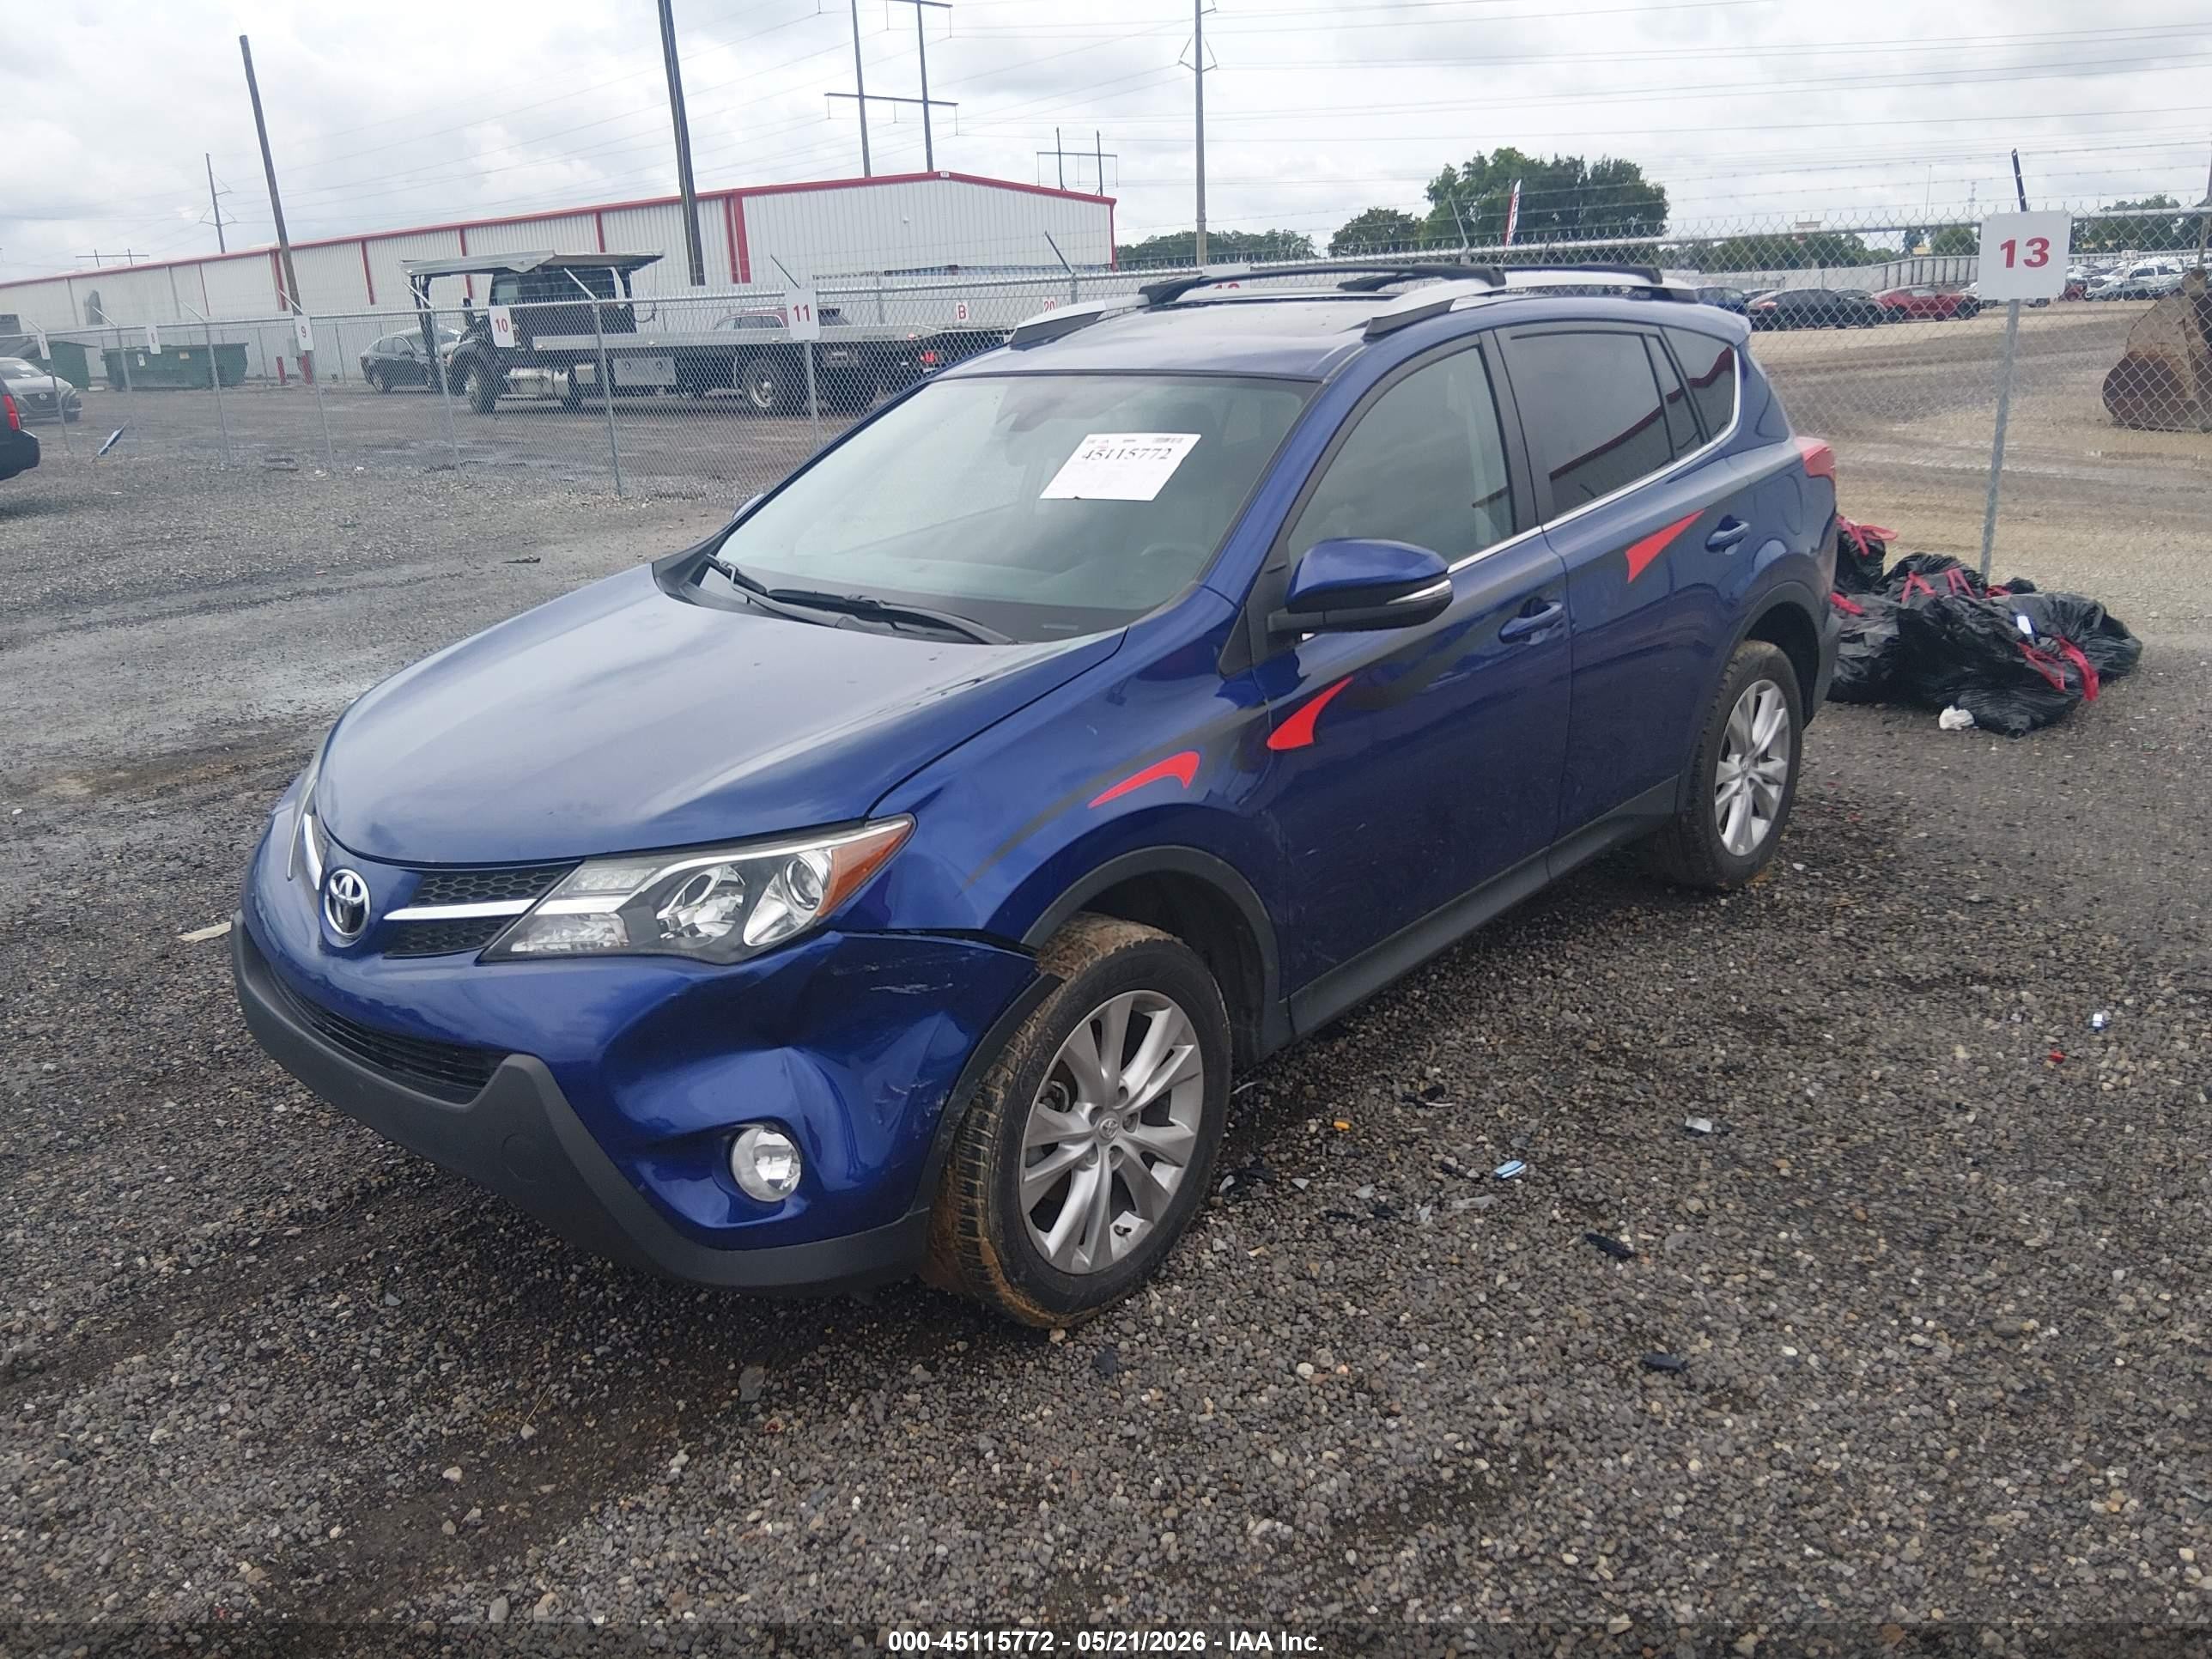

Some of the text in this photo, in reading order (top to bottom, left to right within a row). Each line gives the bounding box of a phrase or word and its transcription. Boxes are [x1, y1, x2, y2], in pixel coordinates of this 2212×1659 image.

[2000, 237, 2051, 269] 13
[793, 304, 810, 323] 11
[957, 304, 967, 320] B
[301, 325, 307, 338] 9
[495, 318, 508, 333] 10
[1081, 447, 1173, 461] 45115772
